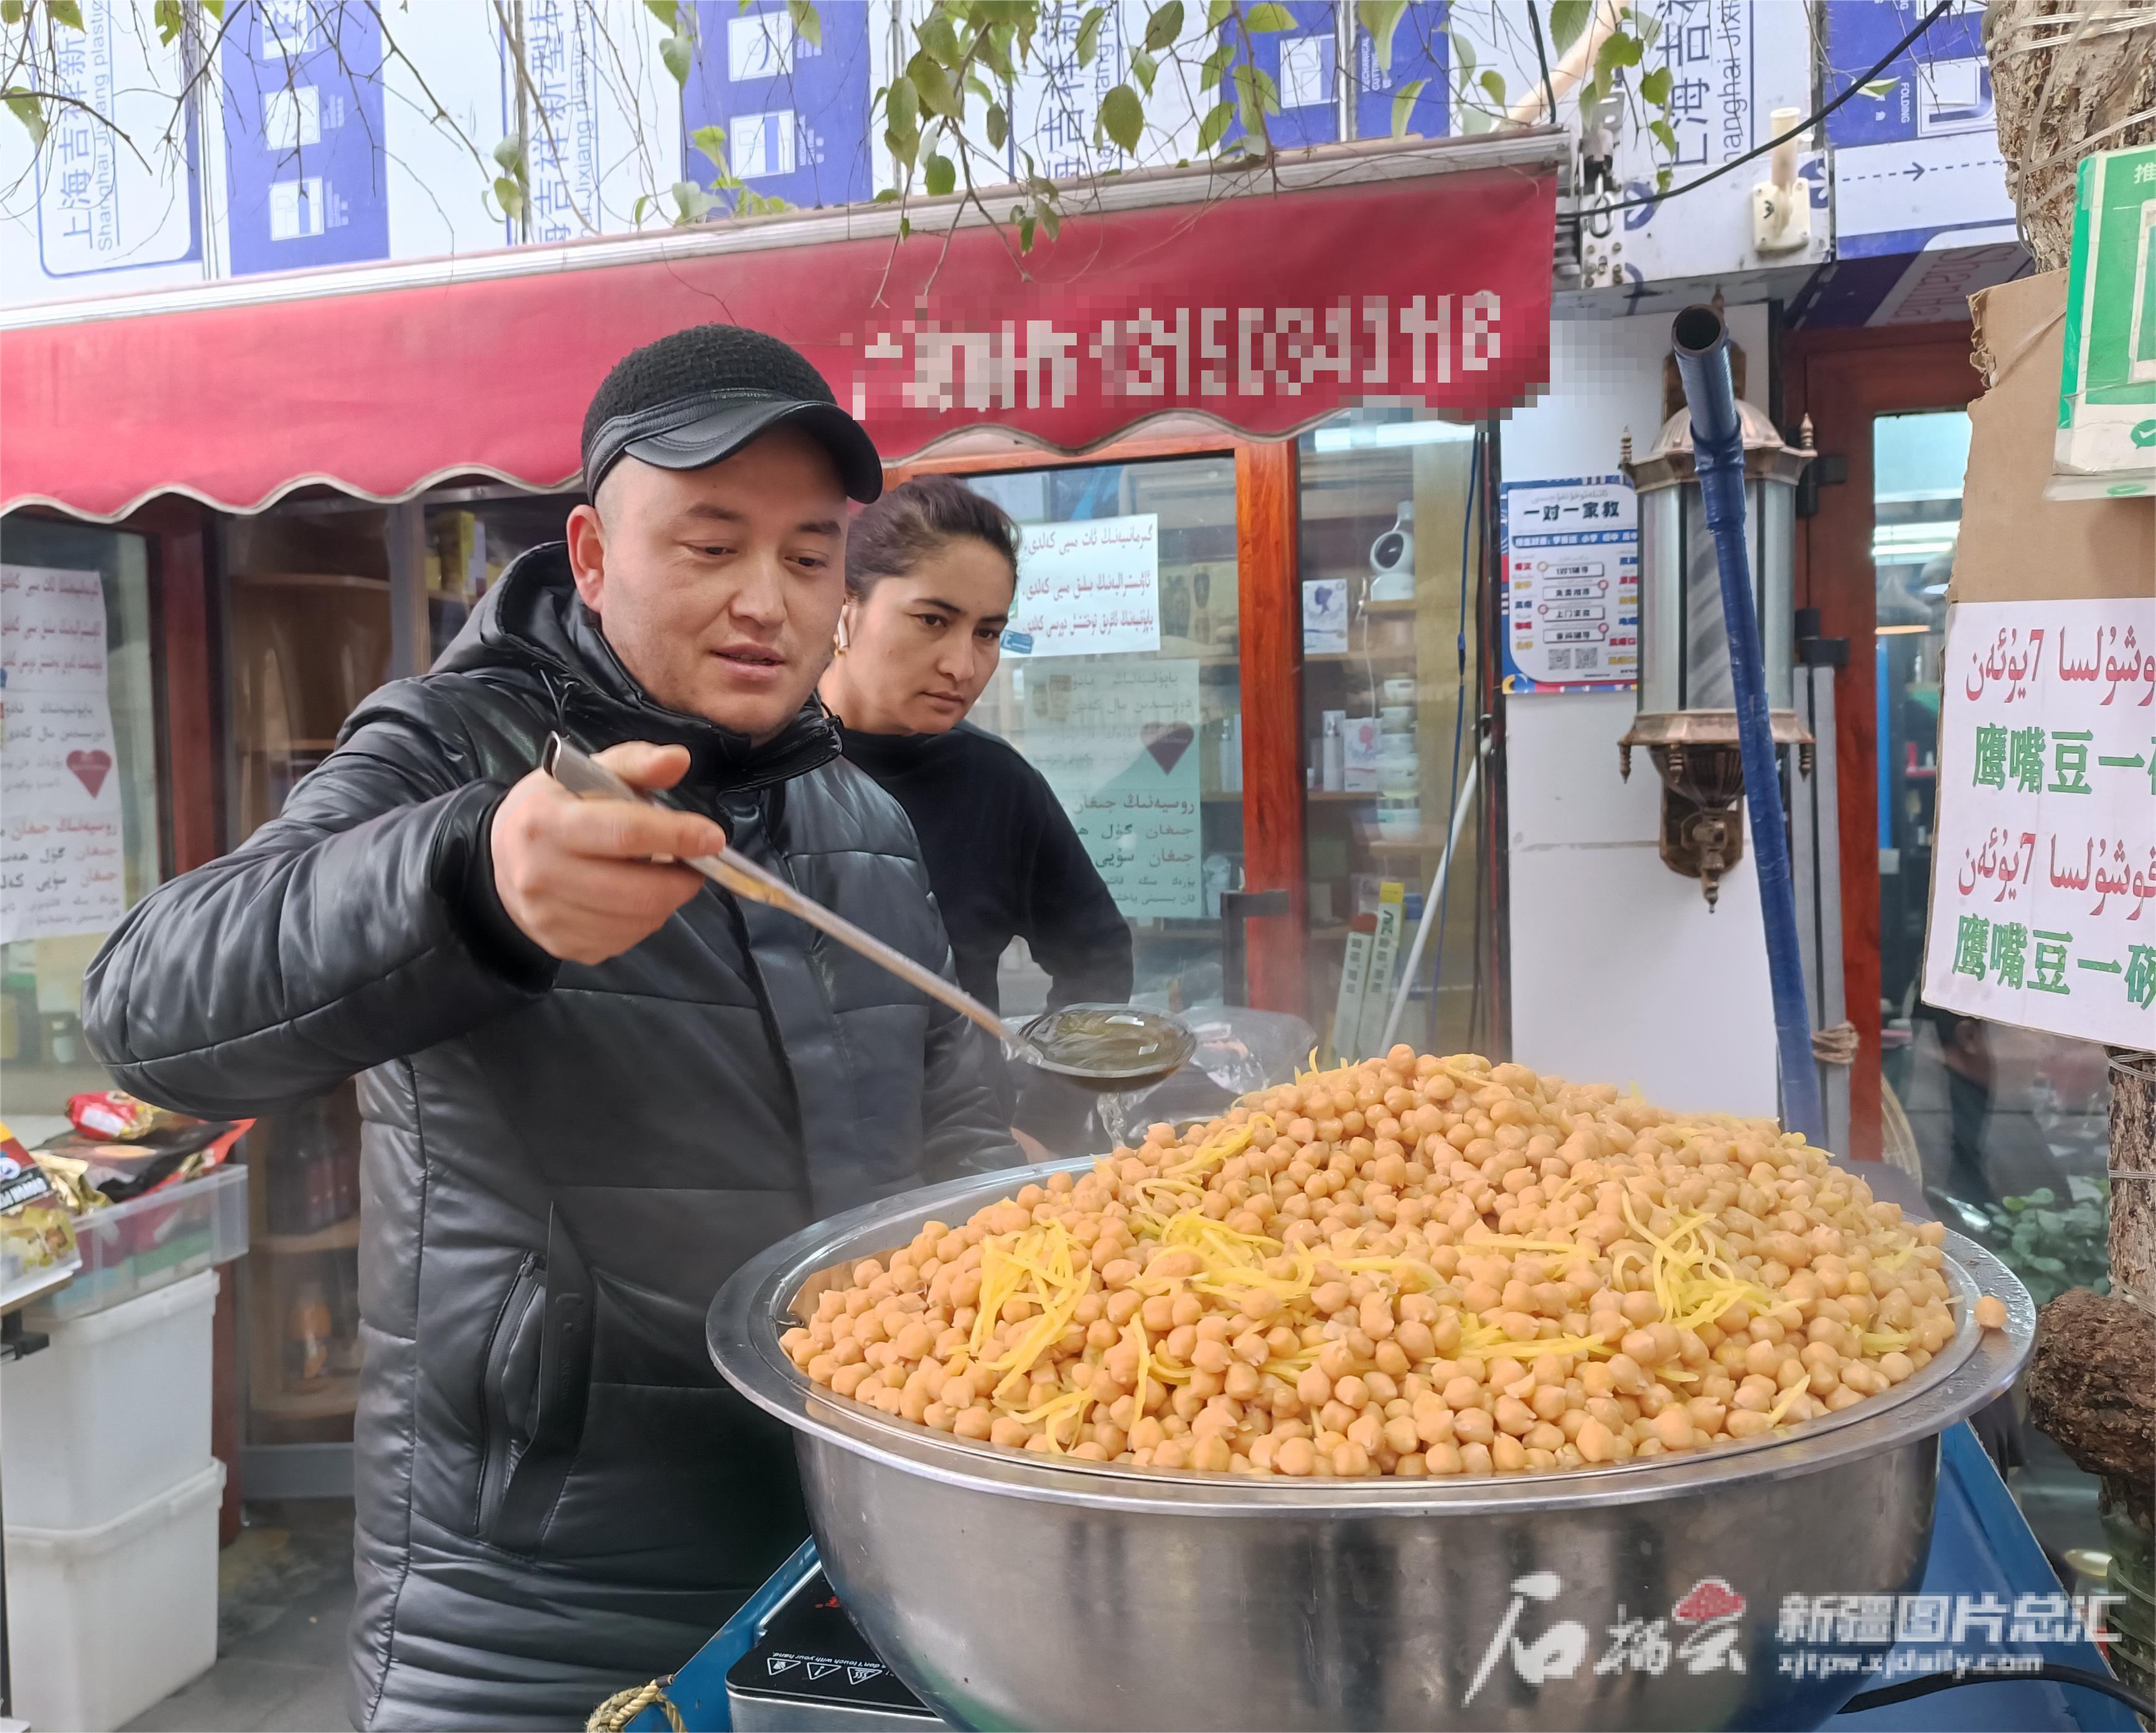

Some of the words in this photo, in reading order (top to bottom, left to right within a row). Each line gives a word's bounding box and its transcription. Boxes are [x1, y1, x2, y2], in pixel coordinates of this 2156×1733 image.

[1716, 57, 1748, 163] anghai
[1900, 82, 1910, 124] FOLDING
[58, 0, 93, 250] 上海吉祥新
[574, 120, 595, 198] Jixiang
[1523, 500, 1620, 522] 一对一家教
[1973, 722, 2156, 795] 鹰嘴豆一
[772, 1651, 795, 1660] hand.
[794, 1653, 817, 1661] your
[815, 1656, 833, 1664] with
[835, 1658, 858, 1667] touch
